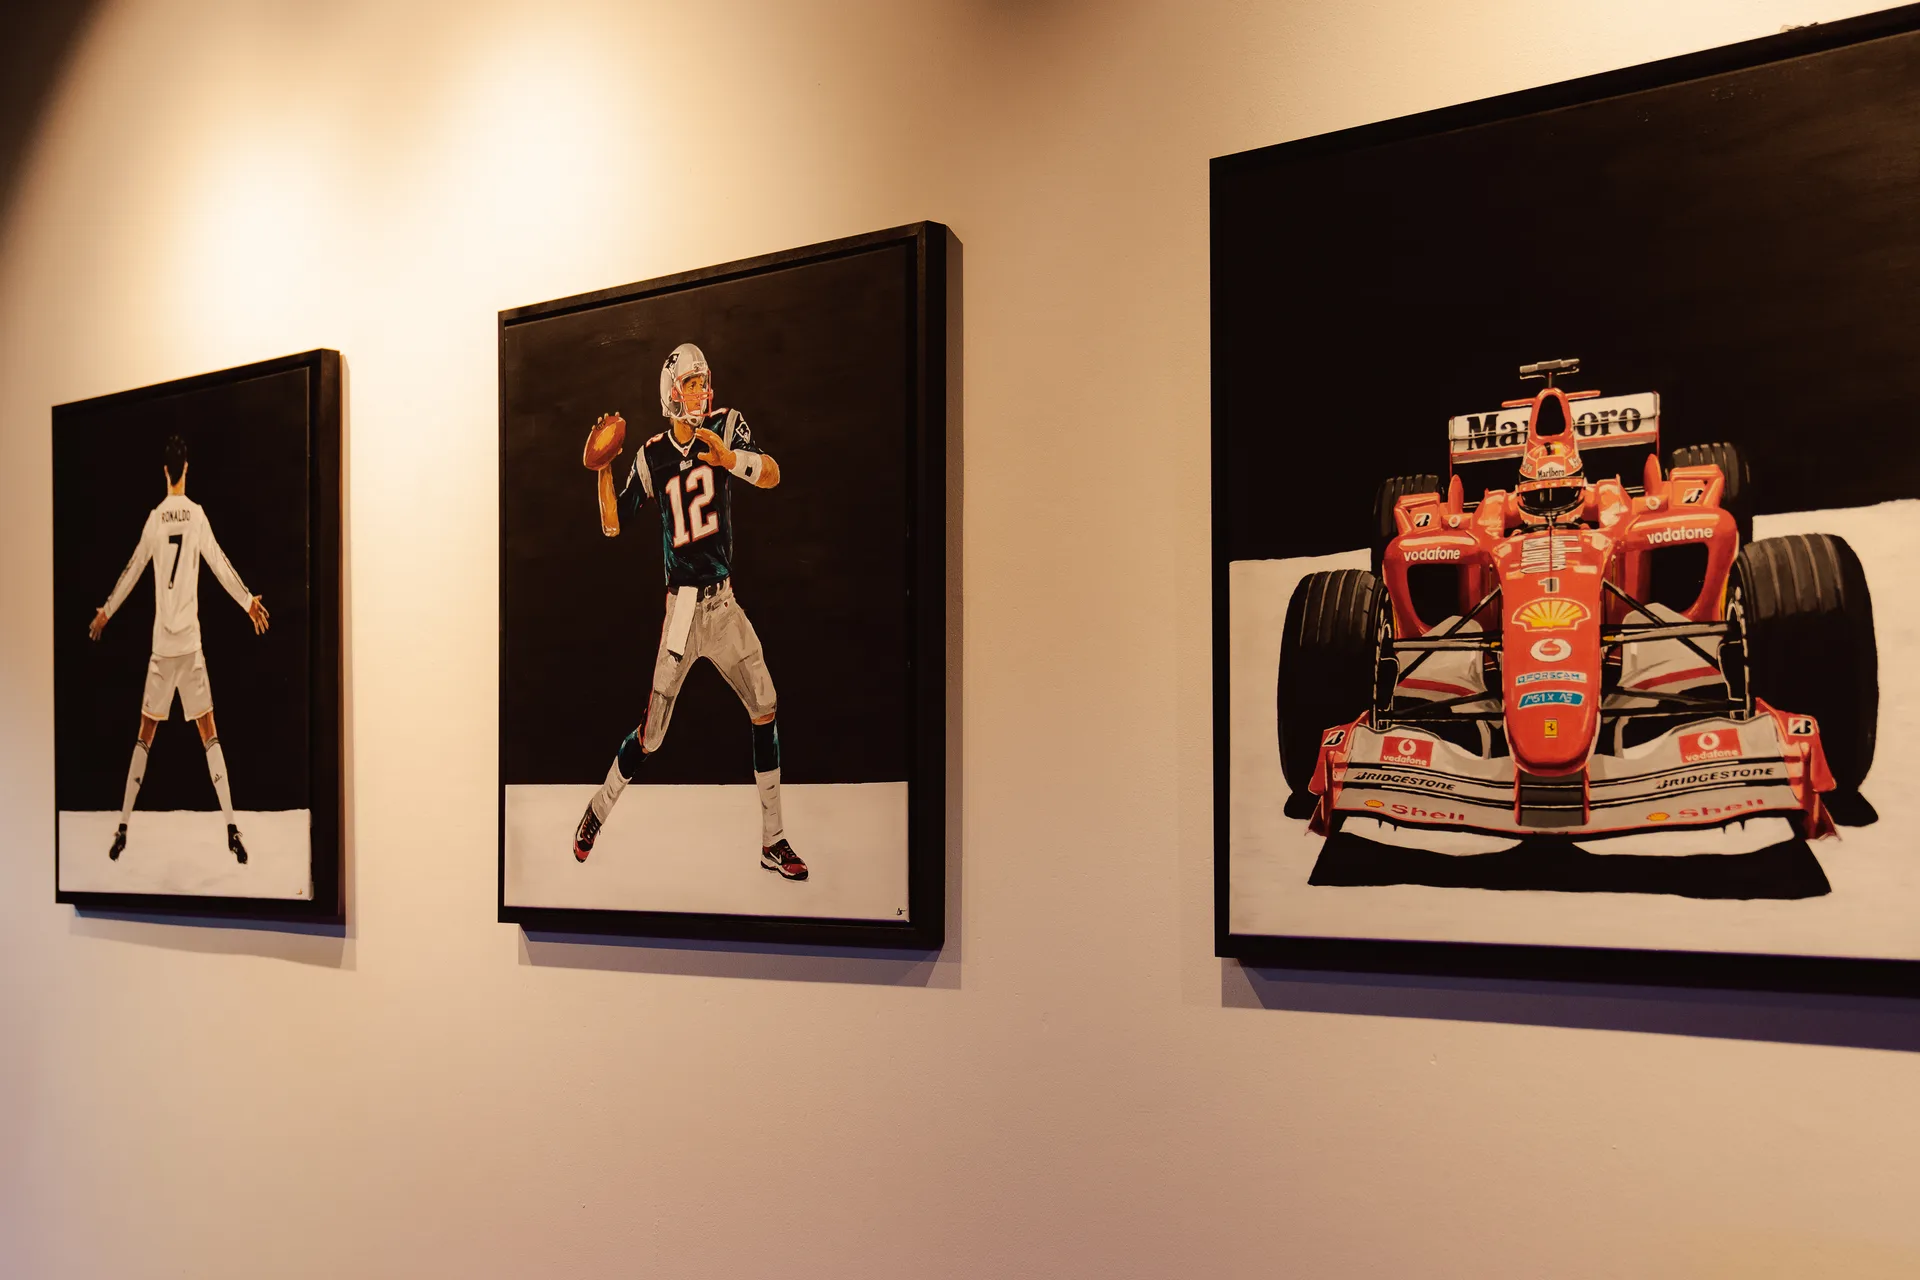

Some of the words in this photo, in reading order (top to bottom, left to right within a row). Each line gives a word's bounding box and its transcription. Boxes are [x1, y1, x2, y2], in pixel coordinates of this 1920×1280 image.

[1466, 407, 1642, 451] Maroro
[1537, 467, 1565, 478] Marlboro
[665, 464, 719, 548] 12
[161, 509, 191, 523] RONALDO
[1646, 526, 1713, 544] vodafone
[168, 533, 183, 589] 7
[1403, 546, 1461, 562] vodafone
[1537, 577, 1560, 594] 1
[1383, 753, 1428, 766] vodafone
[1685, 750, 1740, 762] vodafone
[1353, 771, 1457, 791] BRIDGESTONE
[1655, 768, 1775, 790] BRIDGESTONE
[1391, 804, 1465, 821] Shell
[1678, 799, 1764, 819] Shell
